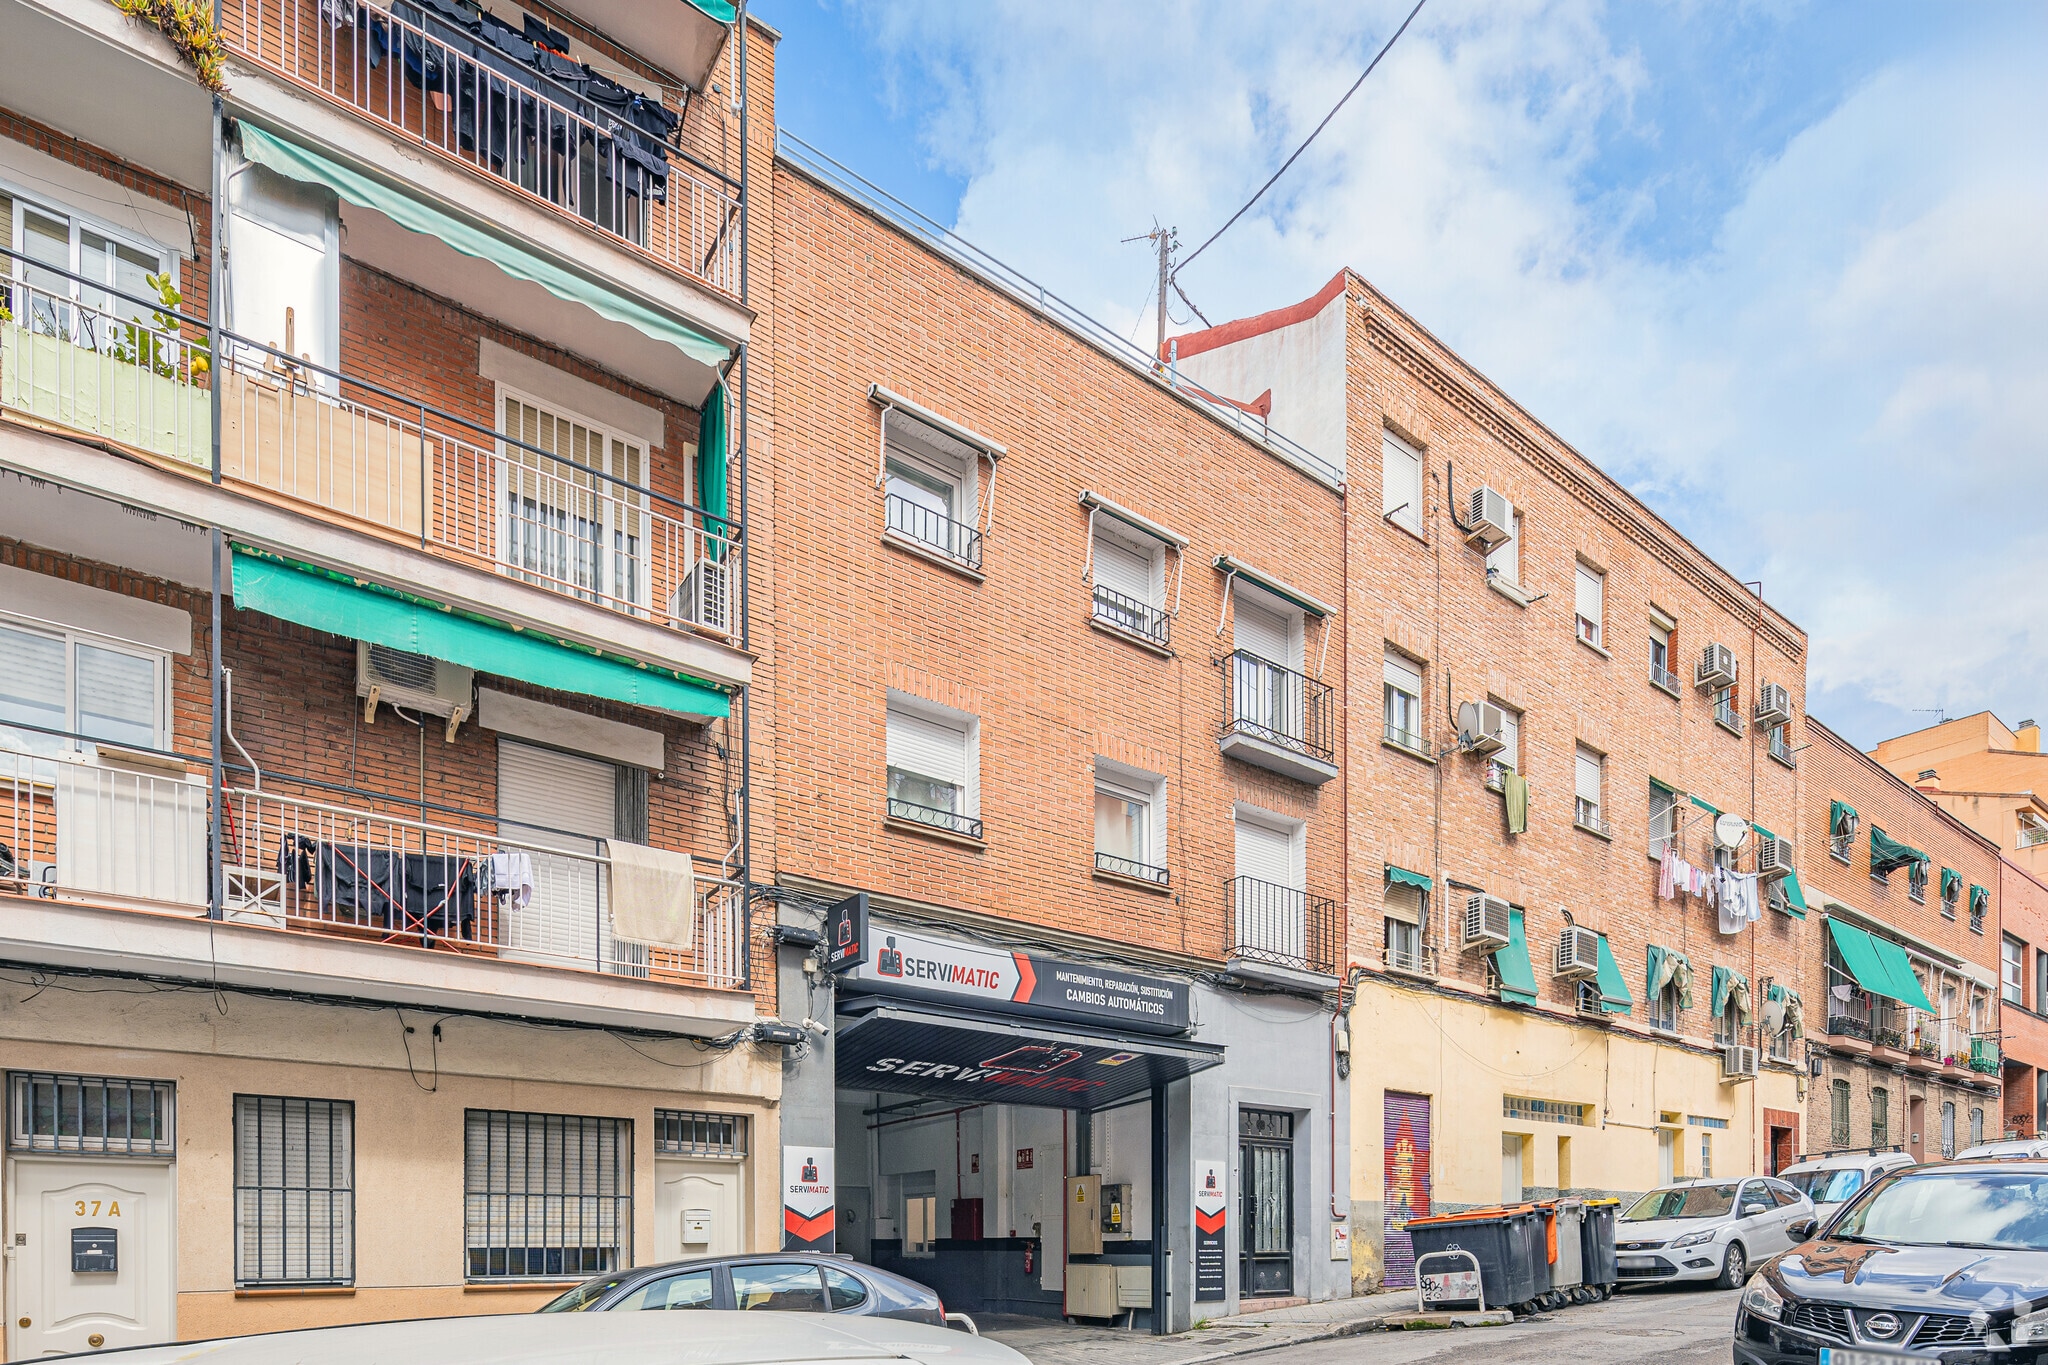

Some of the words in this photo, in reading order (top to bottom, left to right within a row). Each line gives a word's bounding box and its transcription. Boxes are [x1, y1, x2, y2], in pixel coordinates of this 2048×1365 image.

[830, 942, 859, 963] SERVIMATIC
[905, 957, 1000, 989] SERVIMATIC
[1056, 971, 1104, 989] MANTENIMIENTO,
[1105, 979, 1139, 995] REPARACIÓN,
[1140, 985, 1173, 1000] SUSTITUCIÓN
[1066, 989, 1106, 1006] CAMBIOS
[1108, 997, 1164, 1015] AUTOMÁTICOS
[789, 1185, 830, 1194] SERVIMATIC
[75, 1200, 102, 1217] 37
[108, 1200, 121, 1217] A
